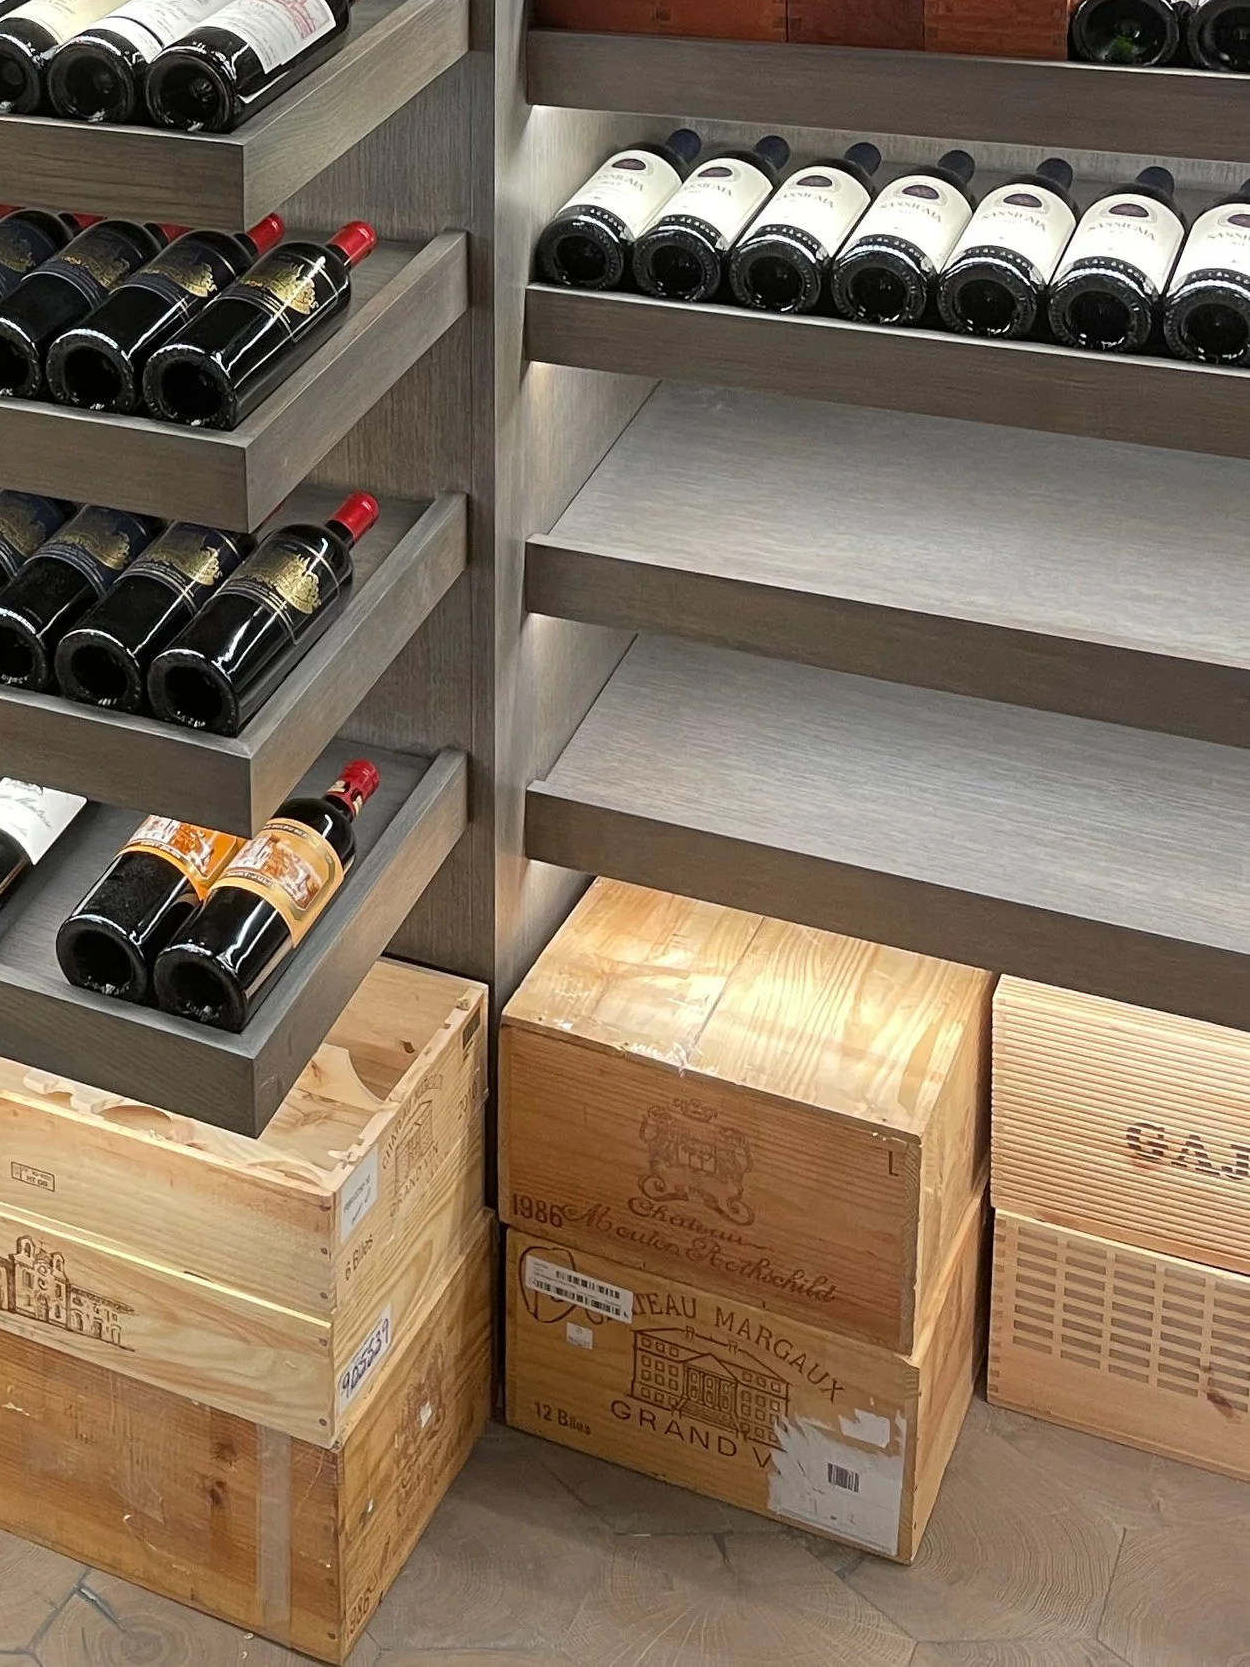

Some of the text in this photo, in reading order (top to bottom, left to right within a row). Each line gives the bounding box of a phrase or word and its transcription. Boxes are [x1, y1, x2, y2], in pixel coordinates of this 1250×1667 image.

[512, 1193, 564, 1229] 1986
[715, 1307, 846, 1404] MARGAUX
[534, 1400, 553, 1425] 12
[610, 1399, 738, 1458] GRAND
